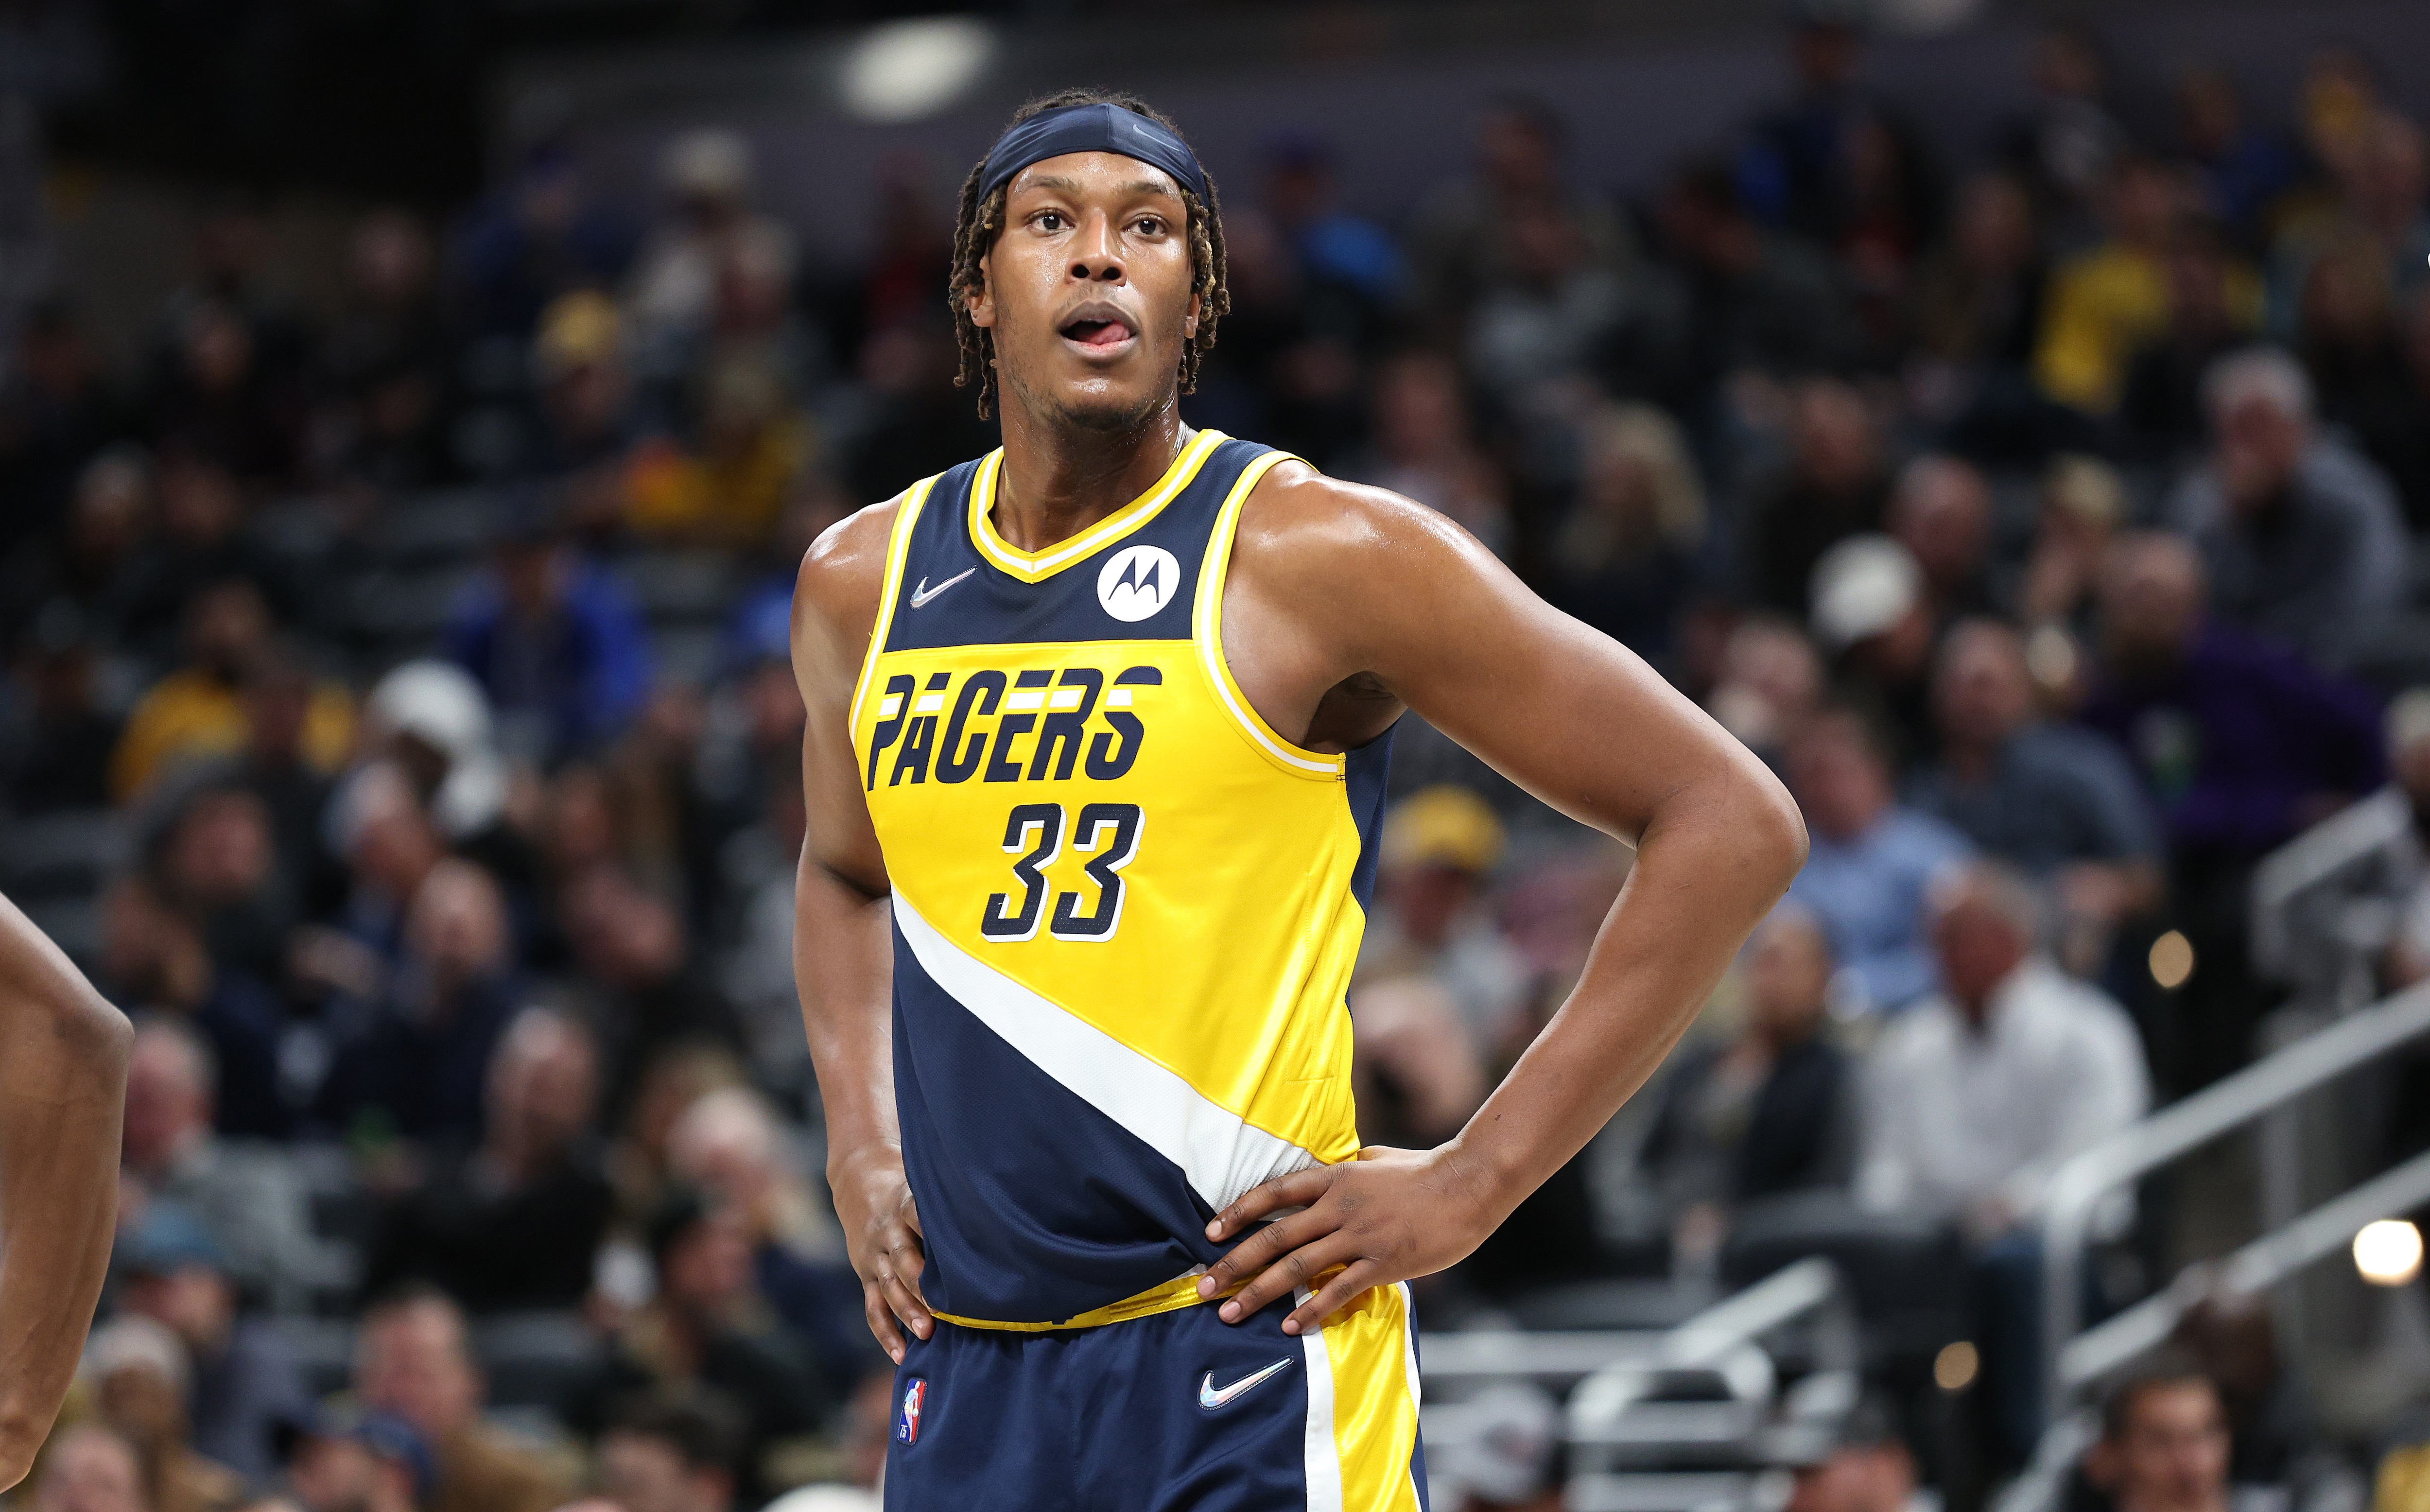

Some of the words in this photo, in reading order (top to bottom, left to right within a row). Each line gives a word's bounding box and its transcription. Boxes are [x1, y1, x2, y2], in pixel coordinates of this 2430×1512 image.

[867, 666, 1163, 792] PACERS
[981, 803, 1146, 943] 33
[900, 1424, 908, 1439] 75
